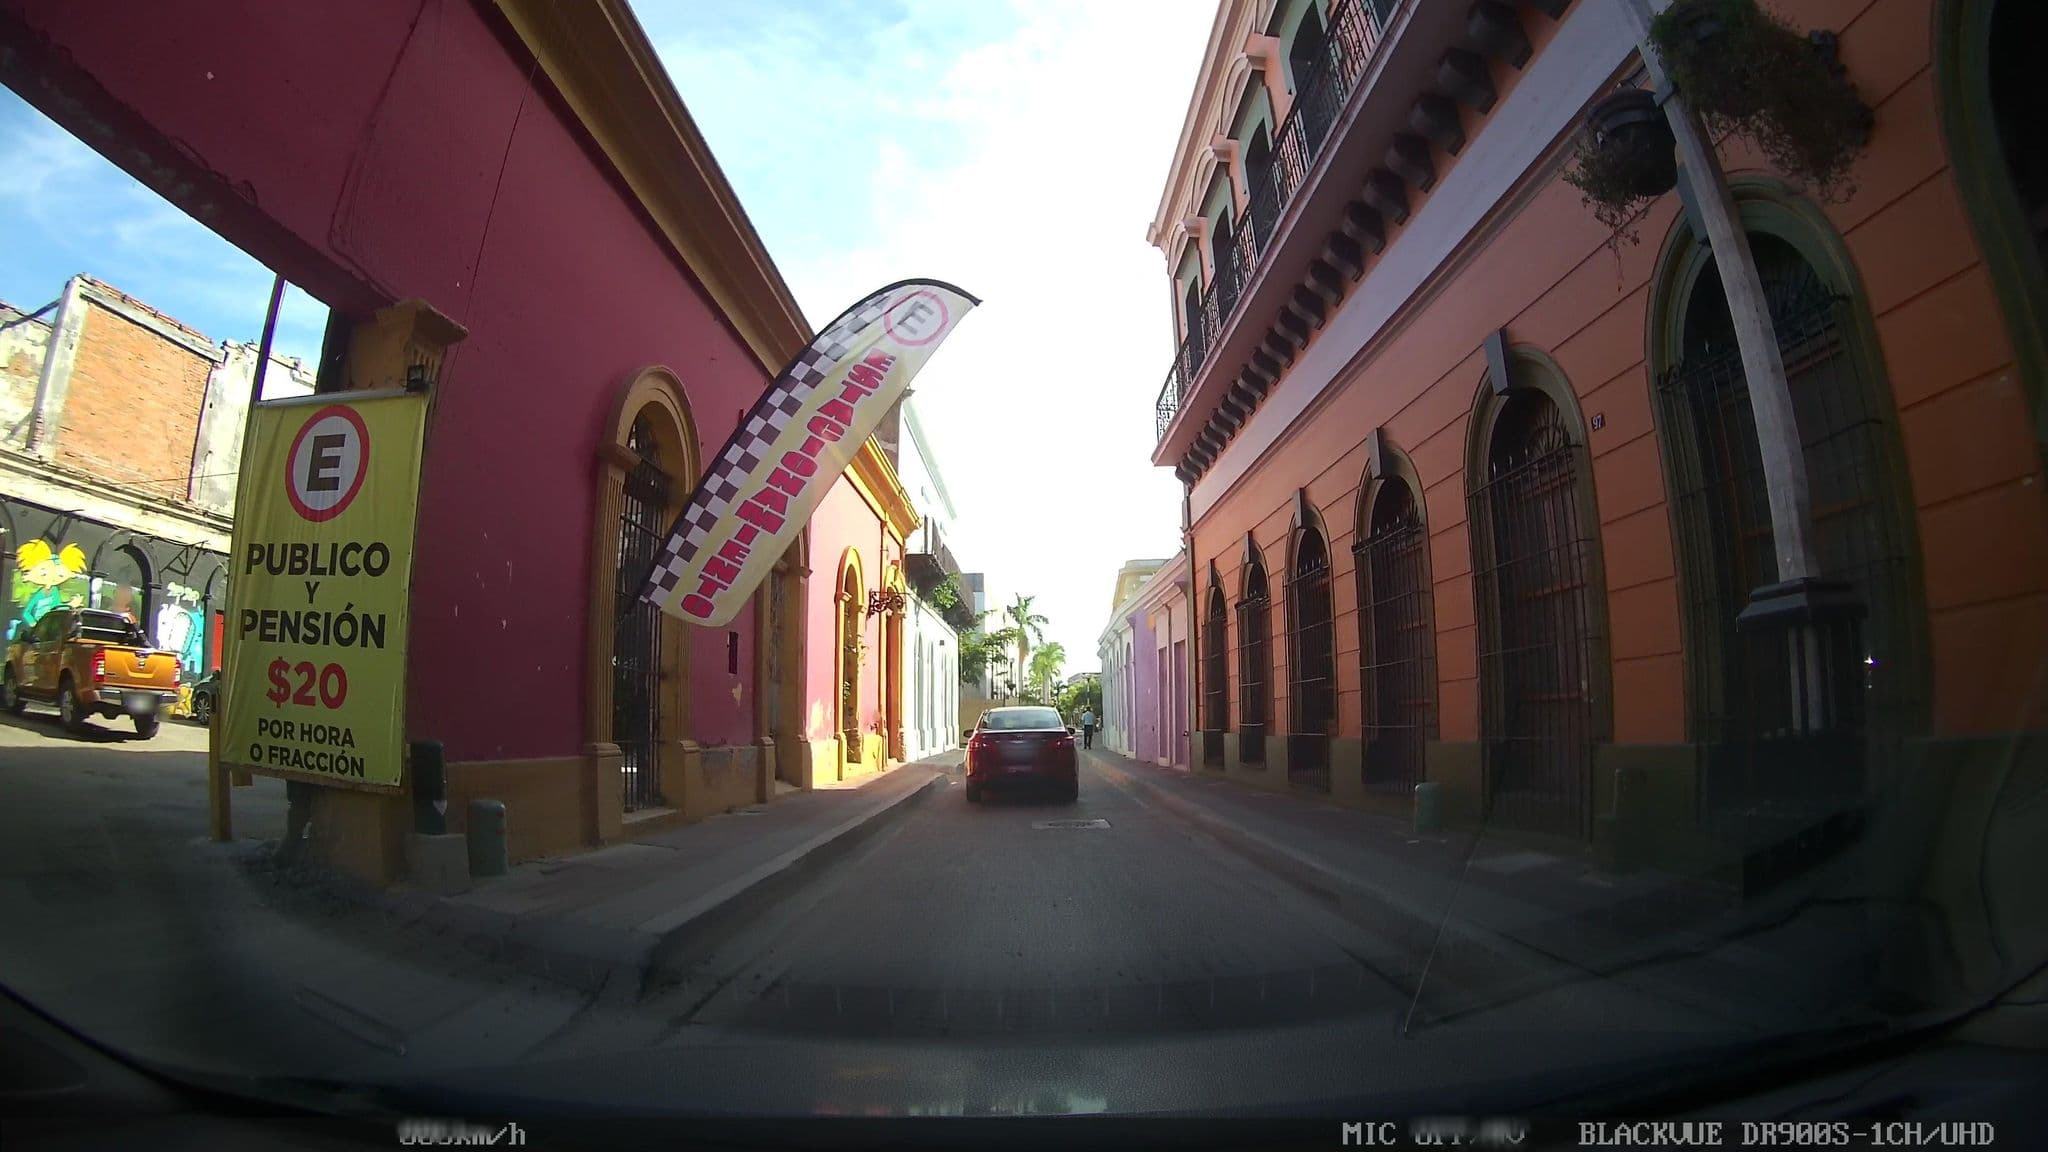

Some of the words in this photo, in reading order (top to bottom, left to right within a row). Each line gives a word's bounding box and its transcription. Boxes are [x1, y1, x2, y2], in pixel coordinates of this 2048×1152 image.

[897, 300, 935, 336] E
[305, 433, 346, 492] E
[680, 347, 897, 619] ESTACIONAMIENTO
[245, 541, 390, 577] PUBLICO
[304, 581, 320, 604] Y
[240, 602, 386, 649] PENSIÓN
[266, 655, 348, 710] $20
[258, 717, 295, 741] POR
[300, 722, 355, 749] HORA
[249, 743, 263, 763] O
[268, 746, 365, 778] FRACCIÓN
